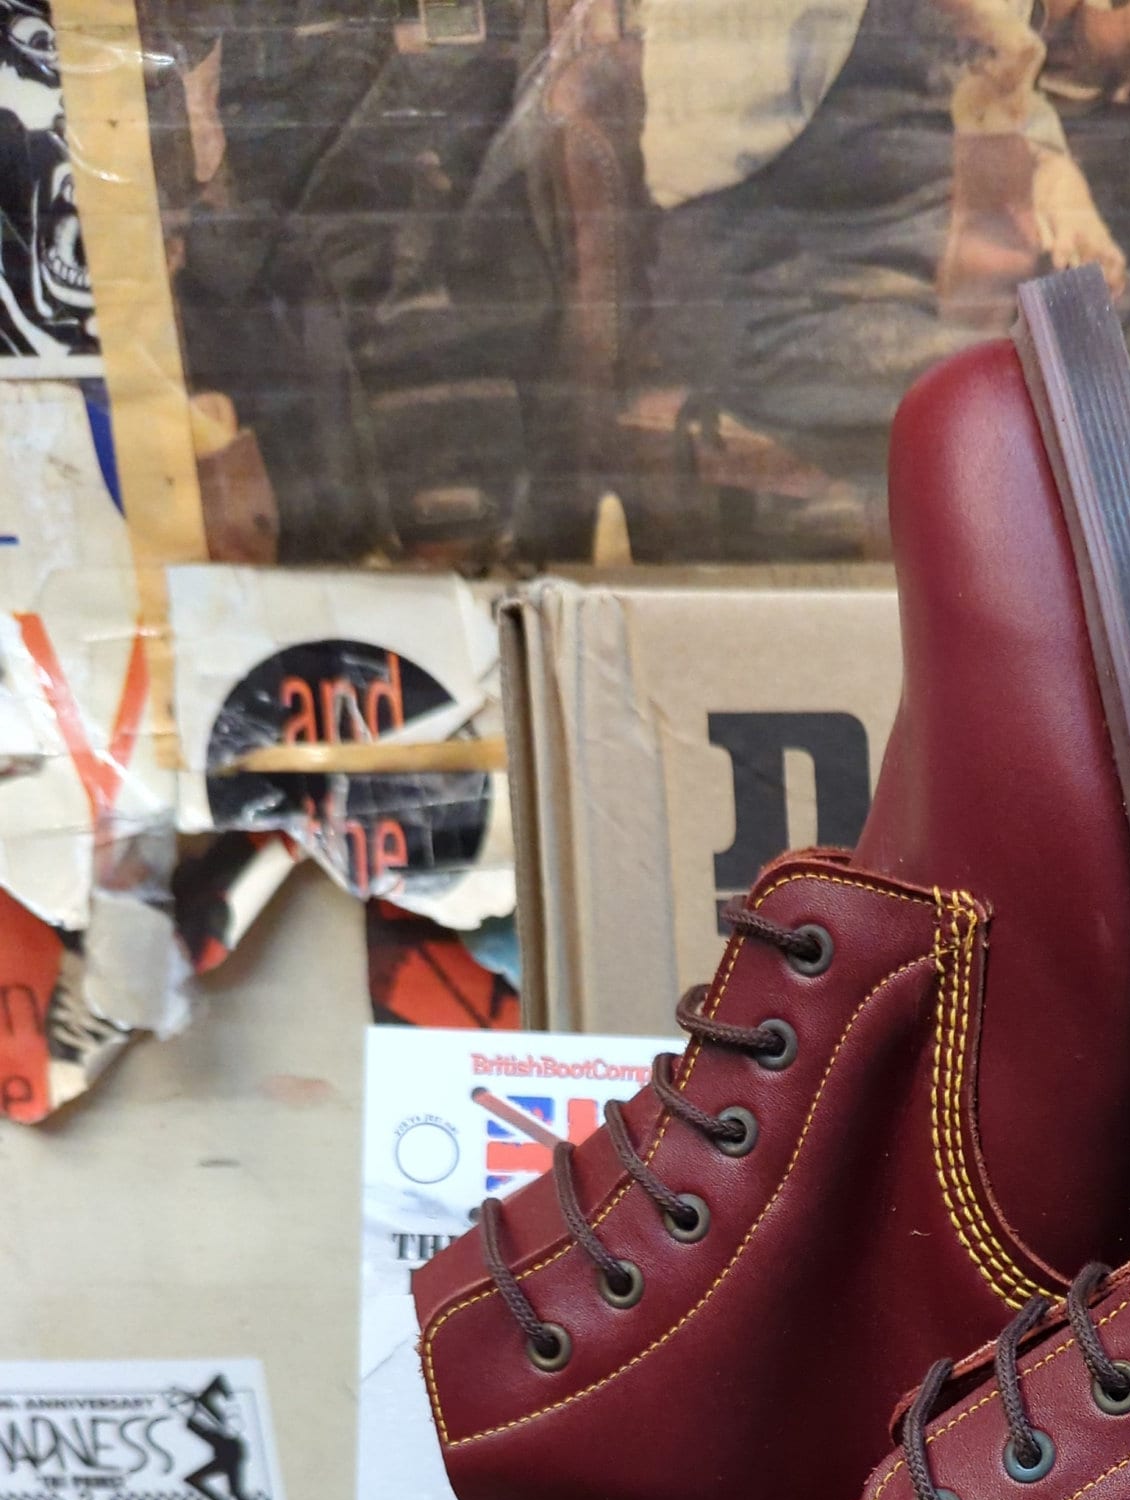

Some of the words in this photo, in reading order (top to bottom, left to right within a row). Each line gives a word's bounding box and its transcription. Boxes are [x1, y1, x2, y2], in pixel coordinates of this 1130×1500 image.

[281, 650, 404, 745] and
[470, 1052, 653, 1086] BritishBootComp
[392, 1232, 460, 1261] TH
